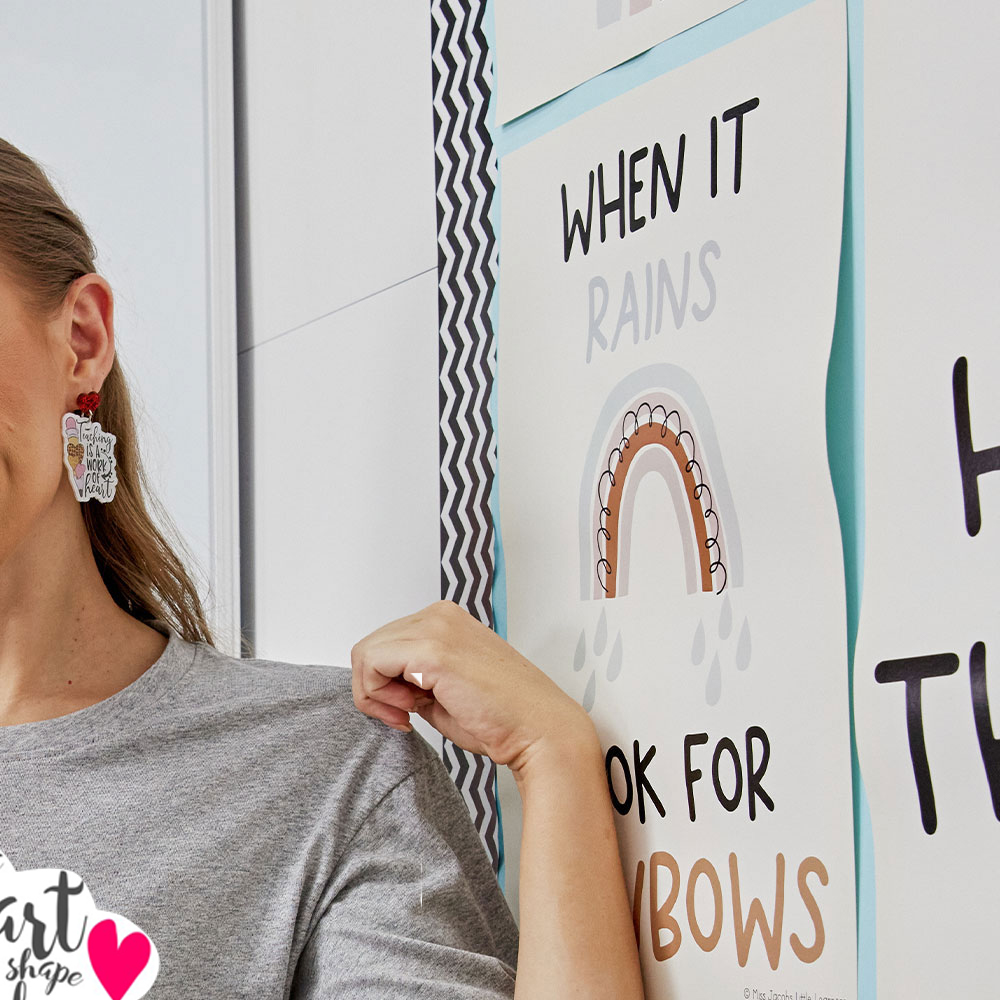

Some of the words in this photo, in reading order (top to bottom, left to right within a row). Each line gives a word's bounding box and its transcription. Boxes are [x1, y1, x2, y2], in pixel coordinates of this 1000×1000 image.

[561, 133, 686, 263] WHEN
[711, 97, 760, 198] IT
[586, 240, 722, 364] RAINS
[85, 473, 114, 499] heart
[86, 459, 107, 473] WORK
[605, 739, 667, 824] OK
[684, 726, 775, 822] FOR
[5, 948, 84, 995] shape
[752, 988, 766, 1000] Miss
